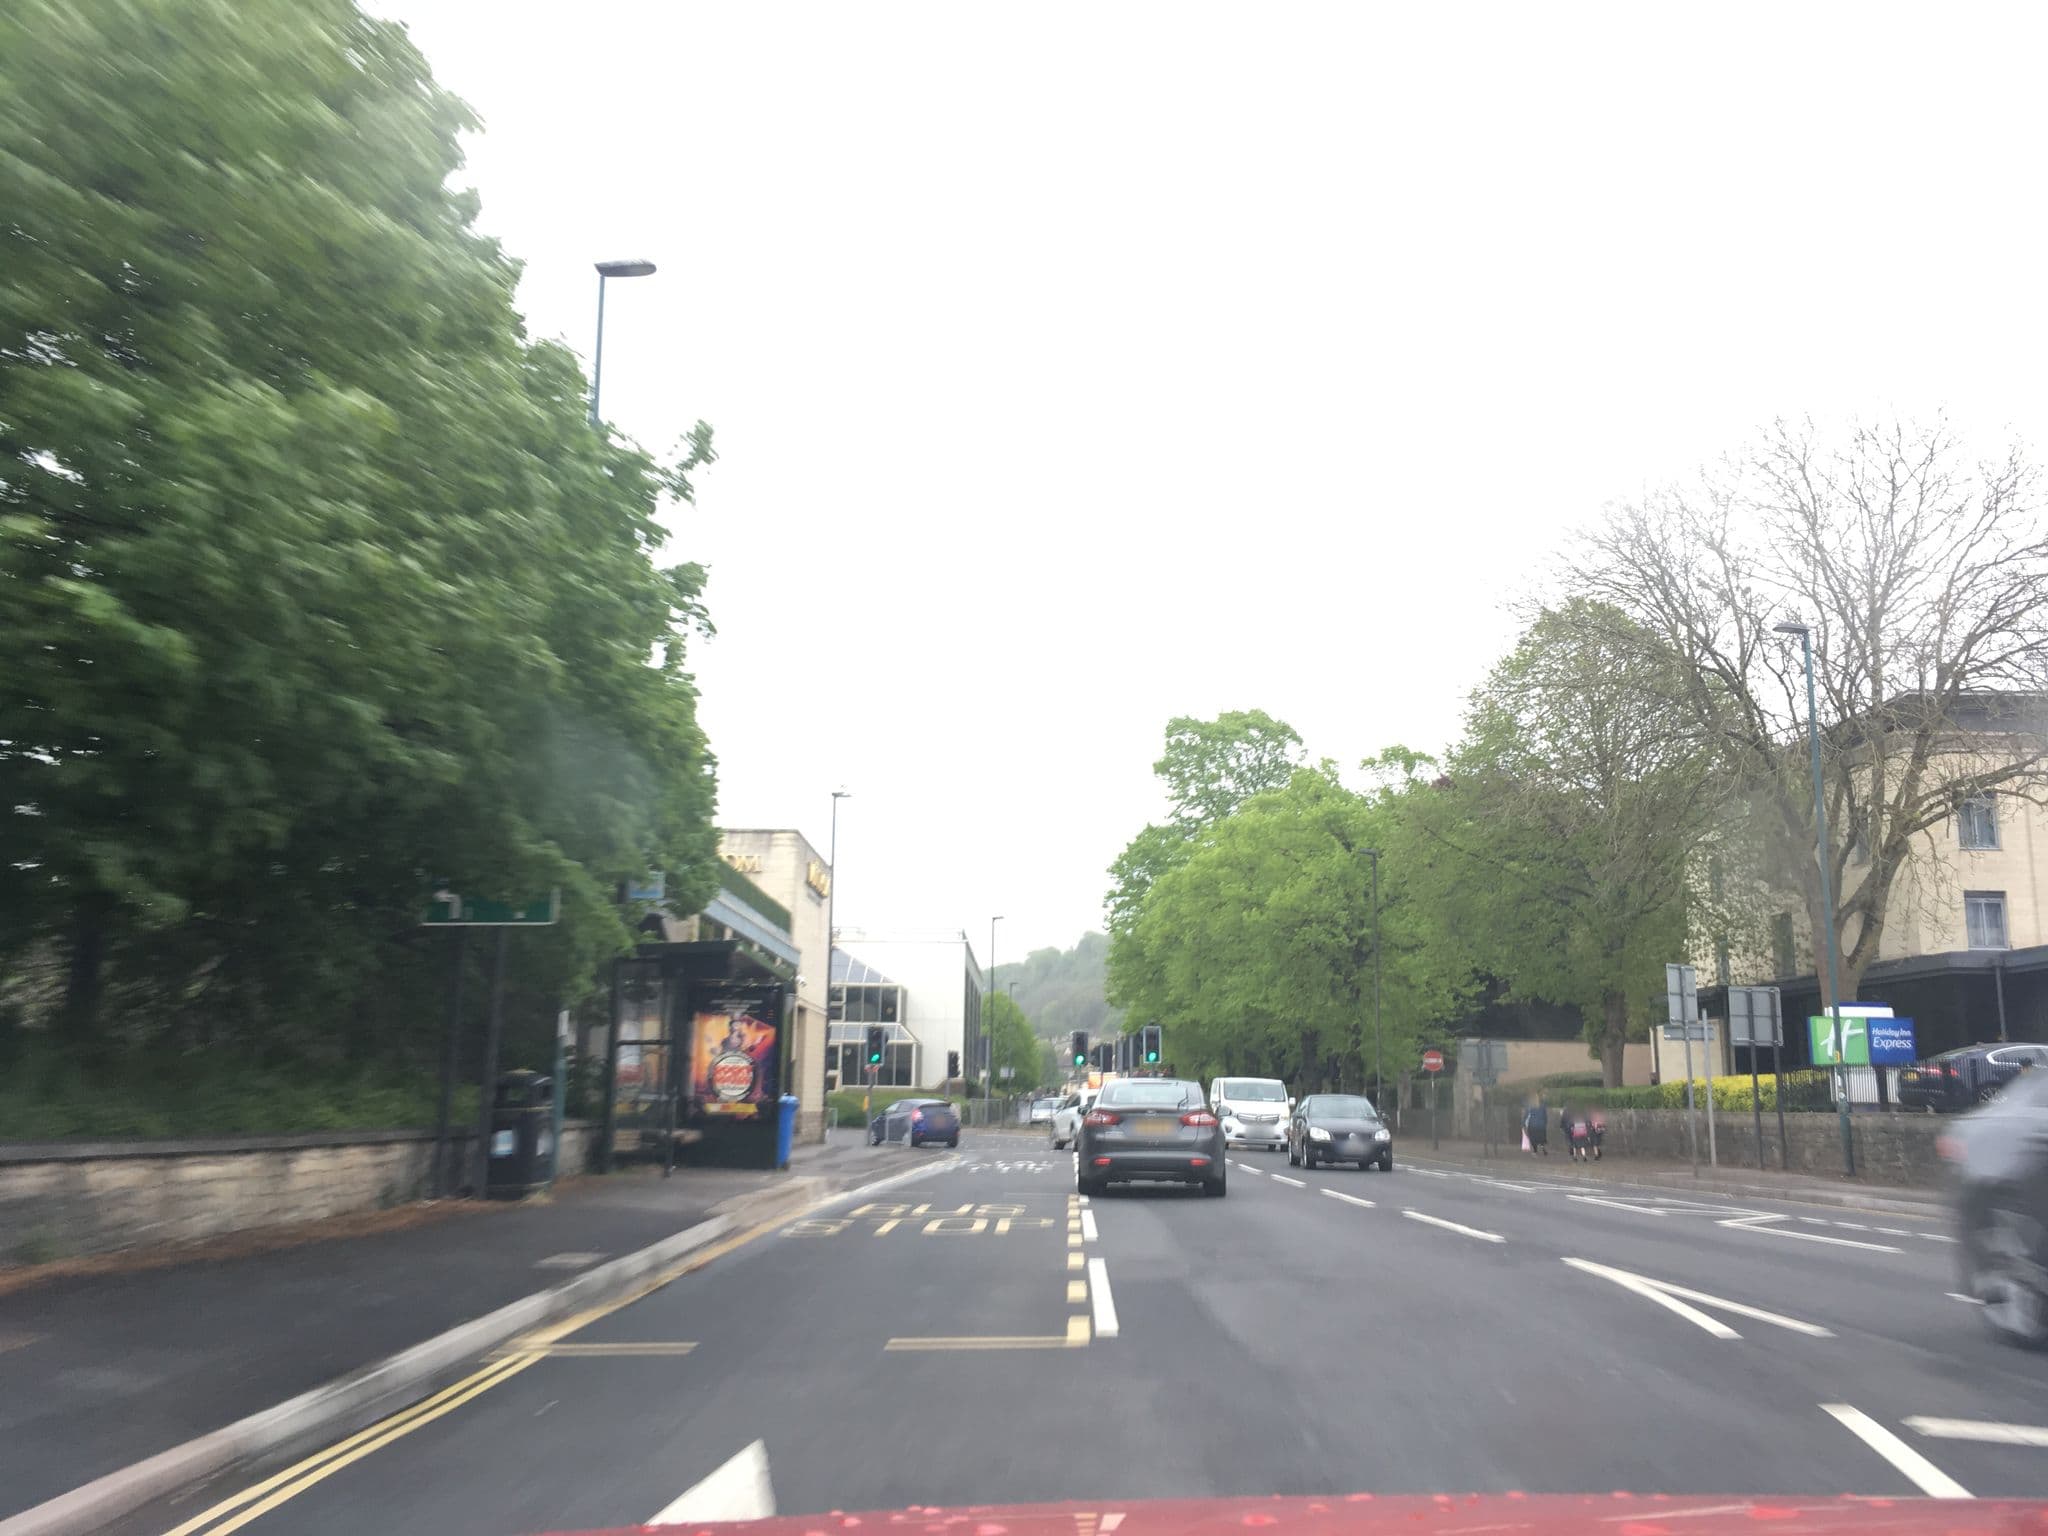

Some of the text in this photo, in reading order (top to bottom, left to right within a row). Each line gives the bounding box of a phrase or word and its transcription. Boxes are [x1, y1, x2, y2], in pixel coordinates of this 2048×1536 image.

[1872, 1027, 1911, 1038] Holiday Inn
[1873, 1036, 1912, 1050] Express
[848, 1203, 1027, 1217] BUS
[779, 1218, 1056, 1237] STOP
